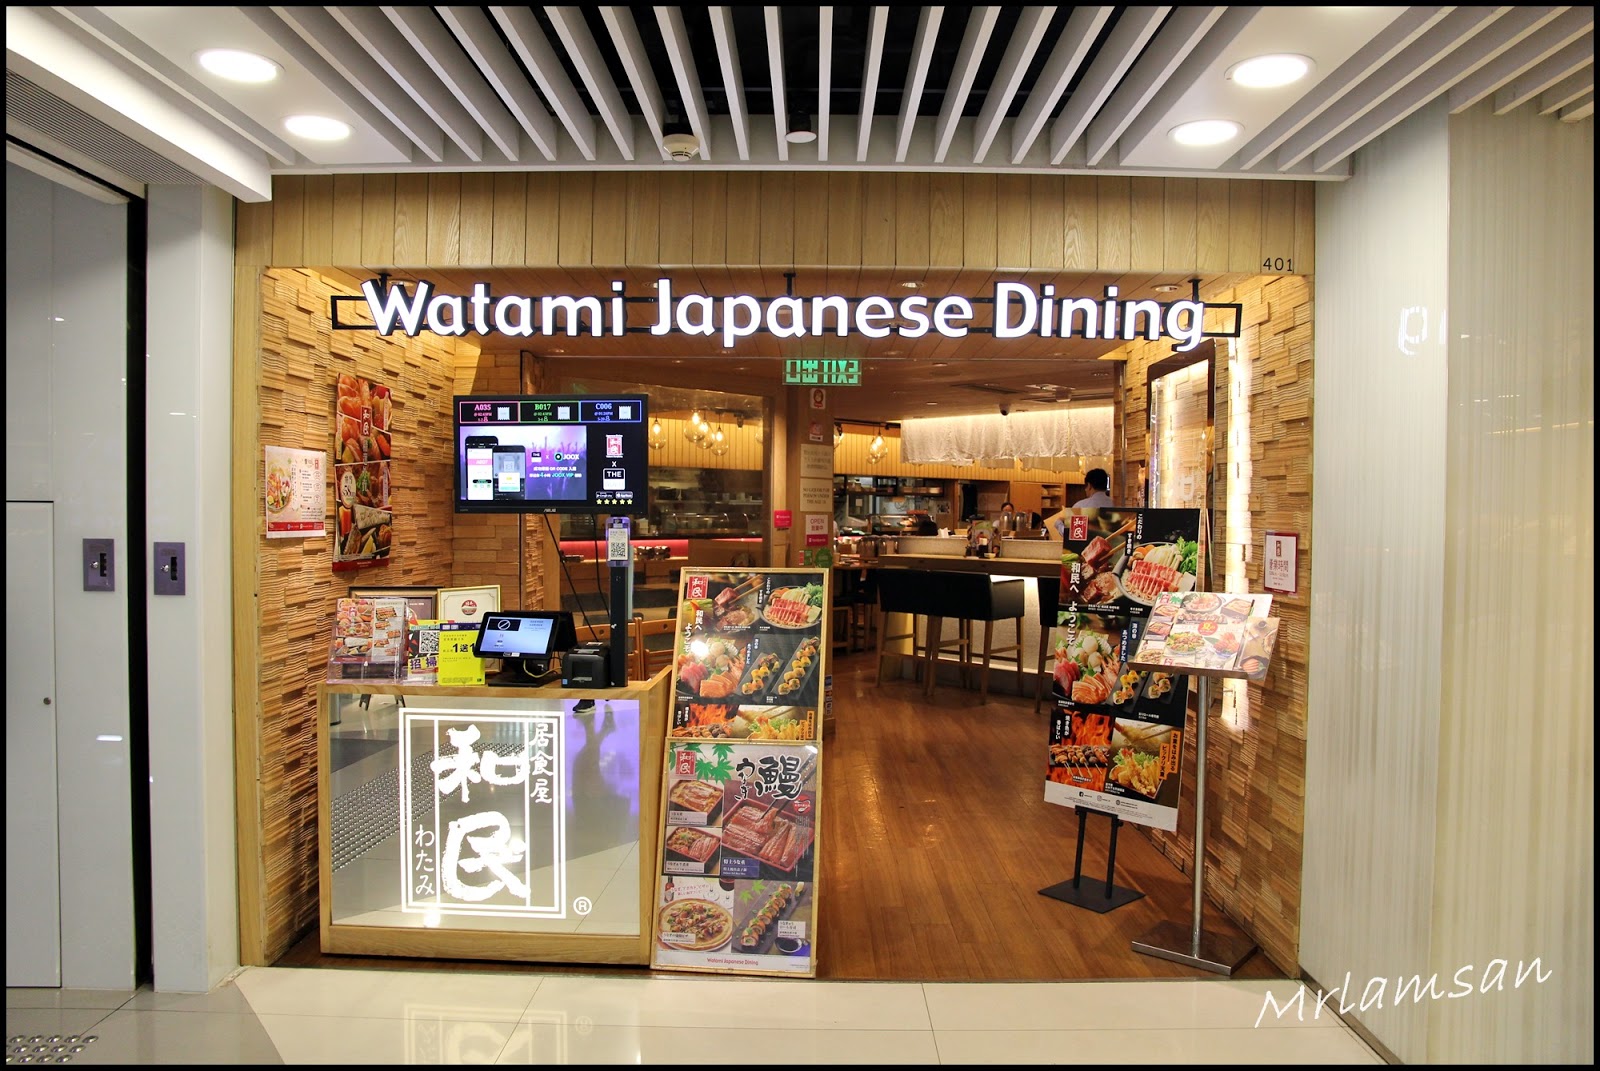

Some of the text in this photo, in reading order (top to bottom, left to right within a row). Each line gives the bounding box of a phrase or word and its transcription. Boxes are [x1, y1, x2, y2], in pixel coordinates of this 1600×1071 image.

[1262, 257, 1294, 272] 401
[361, 277, 1206, 352] Watami Japanese Dining
[534, 403, 552, 411] B017
[1073, 518, 1084, 539] 和民
[694, 609, 704, 631] 和民へ
[1066, 562, 1081, 647] 和民へ ようこそ
[683, 622, 693, 654] ようこそ
[529, 723, 554, 804] 居食屋
[679, 752, 691, 774] 和民
[755, 754, 803, 800] 鰻
[430, 723, 532, 902] 和民
[414, 824, 436, 896] わたみ
[706, 956, 723, 964] Watami
[723, 958, 744, 966] Japanese
